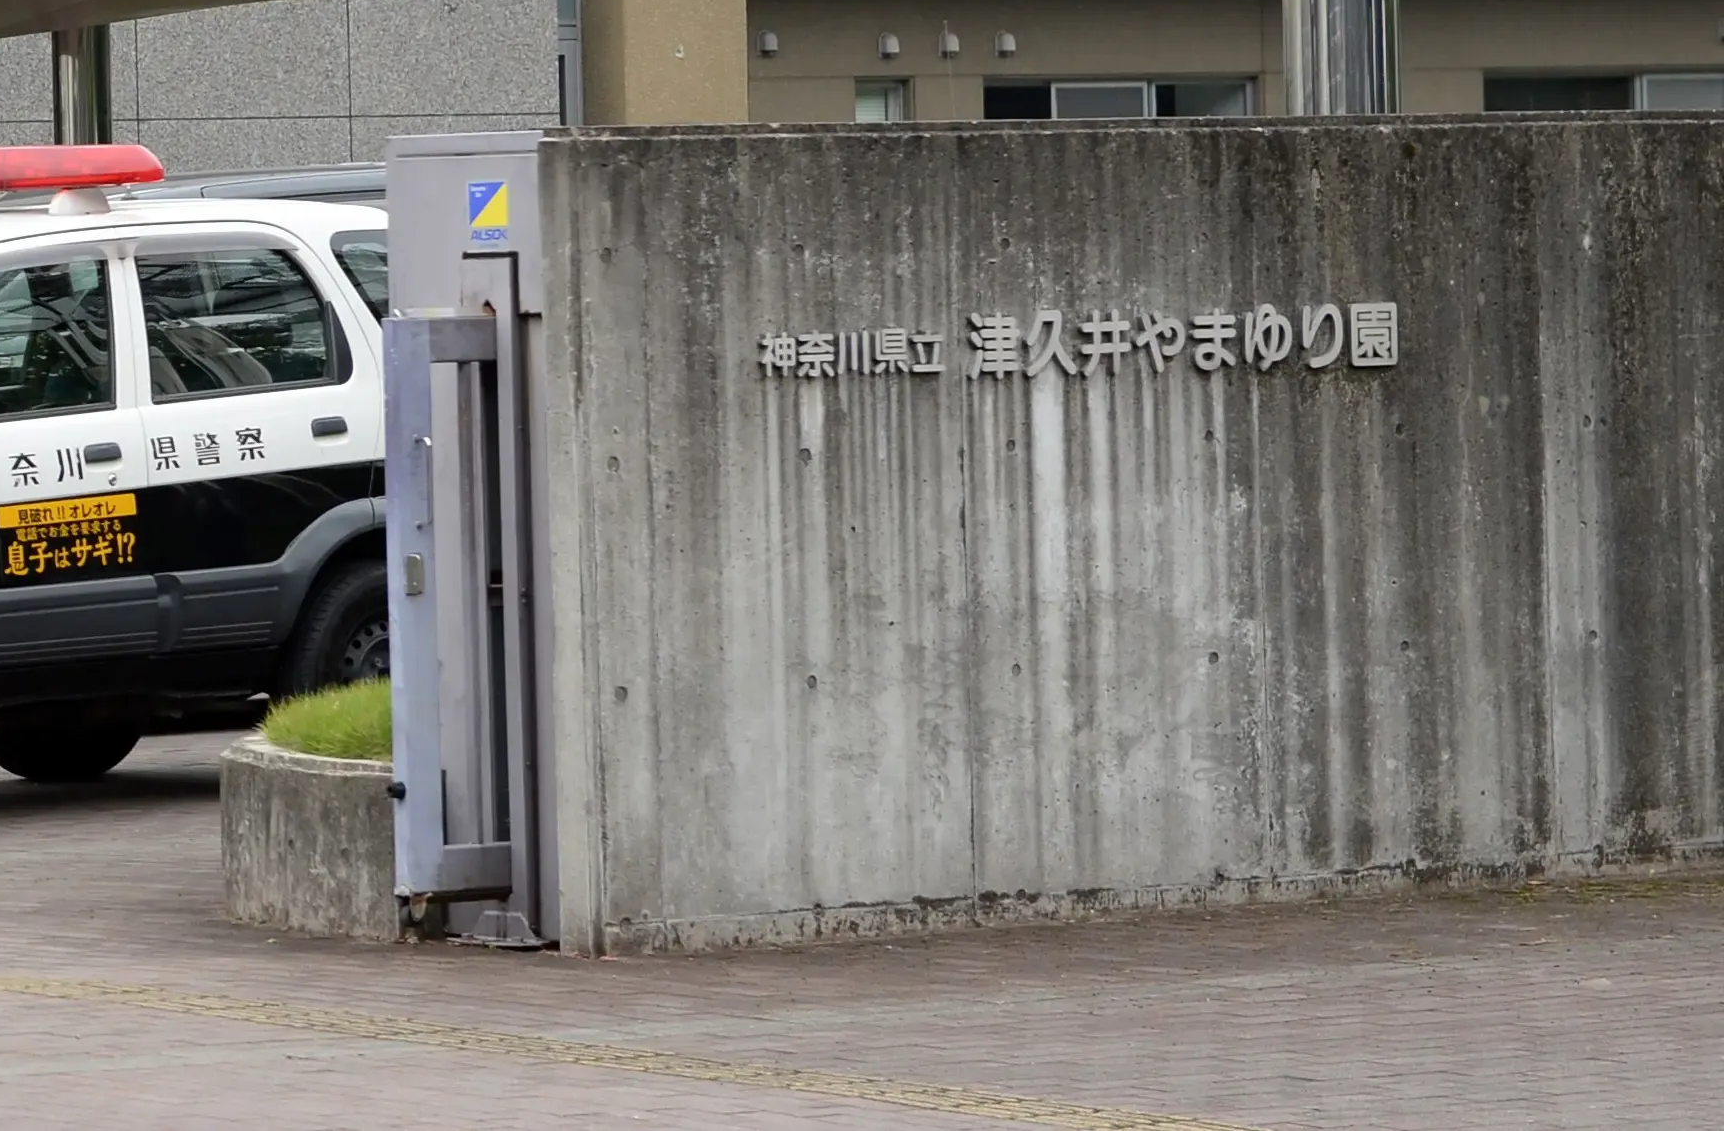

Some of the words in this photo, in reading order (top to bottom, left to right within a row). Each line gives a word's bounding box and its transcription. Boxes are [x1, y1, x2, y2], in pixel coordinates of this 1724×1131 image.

[470, 229, 508, 241] ALSOK
[760, 328, 946, 377] 神奈川県立
[969, 302, 1398, 379] 津久井やまゆり園
